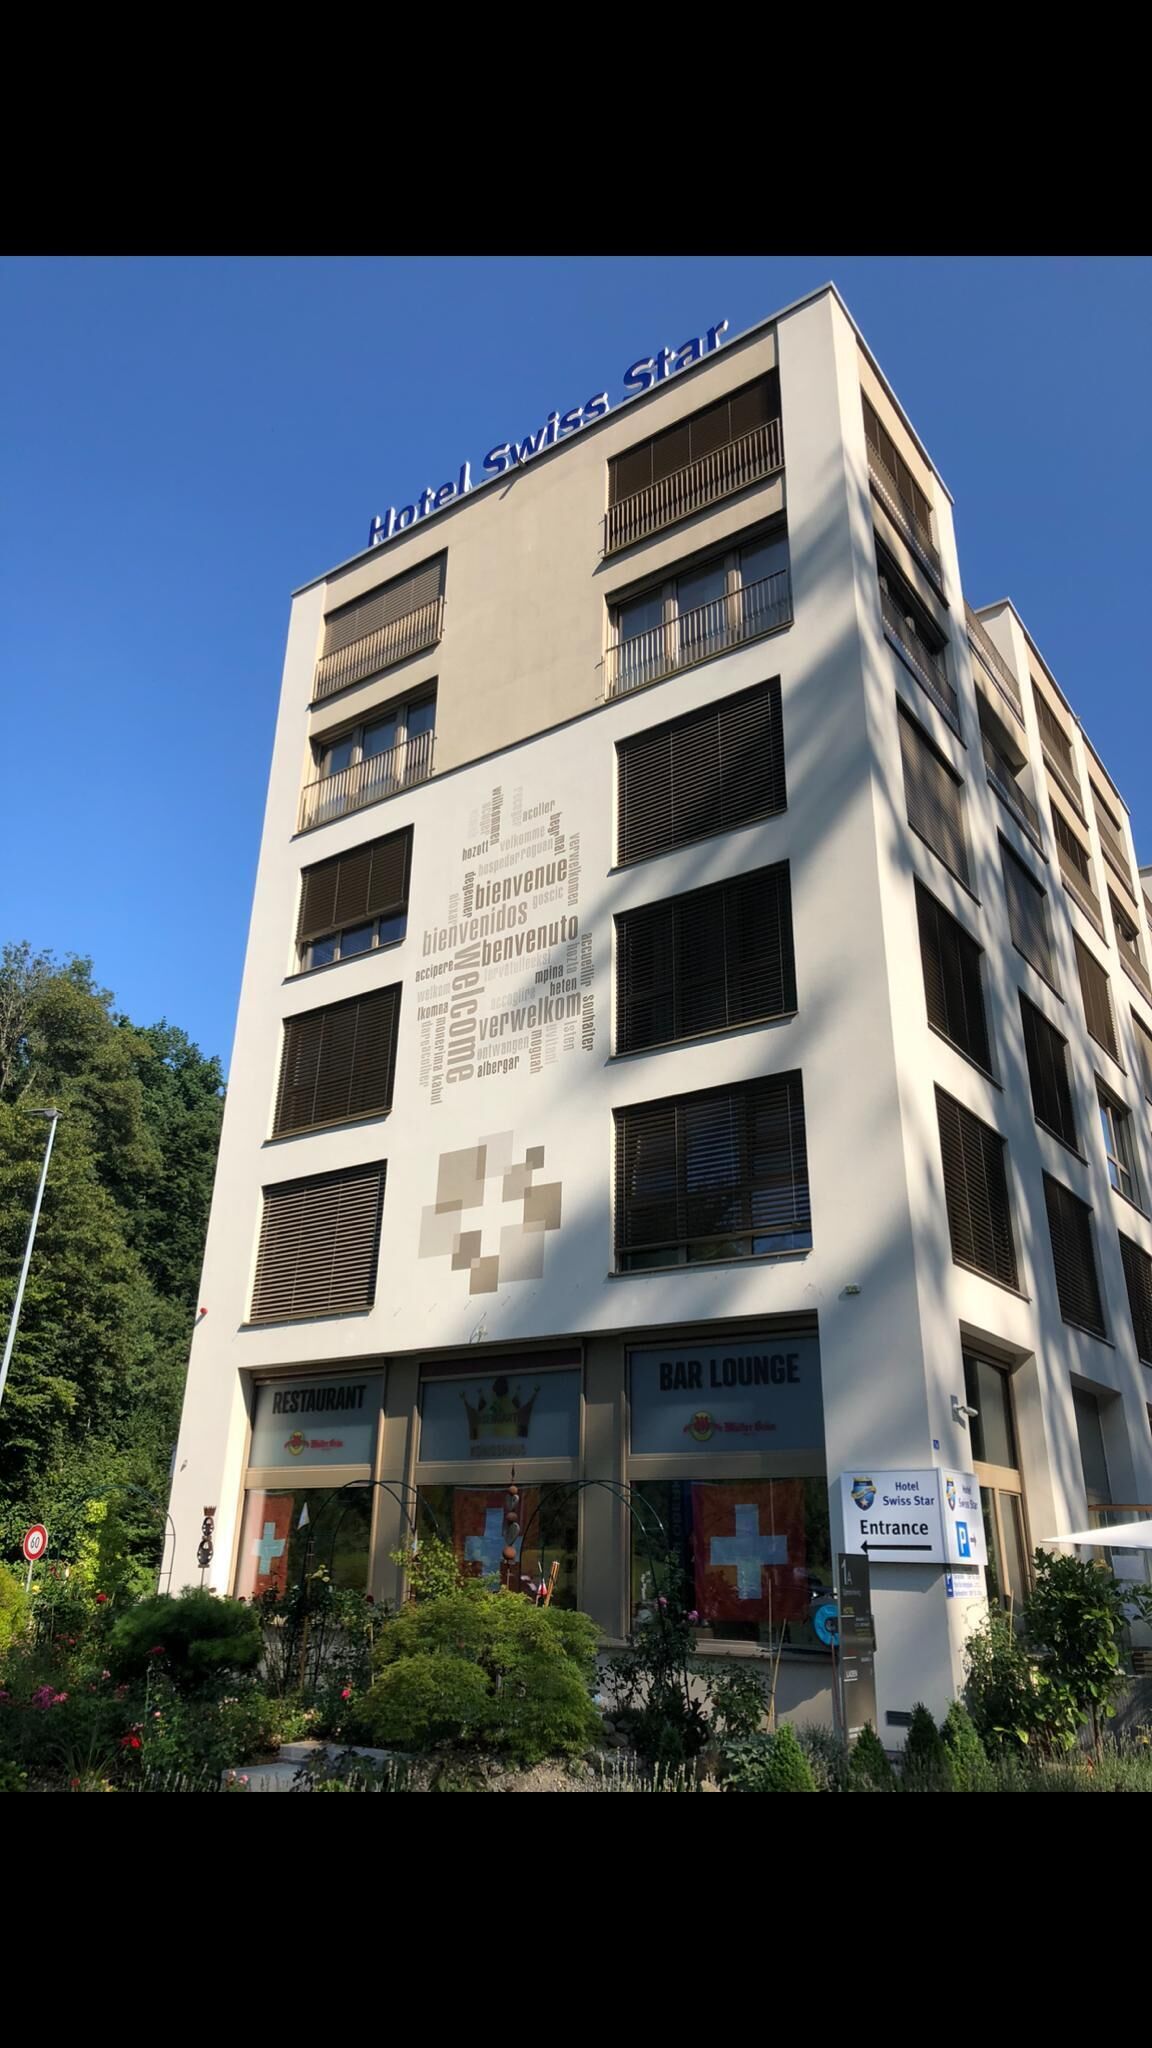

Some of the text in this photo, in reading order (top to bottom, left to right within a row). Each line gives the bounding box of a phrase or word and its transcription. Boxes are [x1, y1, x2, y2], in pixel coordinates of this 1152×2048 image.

[369, 319, 728, 548] Hotel Swiss Star
[475, 858, 567, 910] bienvenue
[423, 901, 528, 957] bienvenidos
[481, 915, 578, 967] benvenuto
[446, 942, 485, 1084] welcome
[479, 991, 581, 1040] verwelkom
[581, 994, 595, 1052] souhaiter
[477, 1056, 519, 1078] albergar
[659, 1353, 800, 1391] BAR LOUNGE
[272, 1385, 367, 1415] RESTAURANT
[882, 1495, 935, 1506] Swiss Star
[895, 1481, 919, 1491] Hotel
[30, 1536, 41, 1550] 60
[860, 1520, 929, 1535] Entrance
[959, 1527, 967, 1554] P
